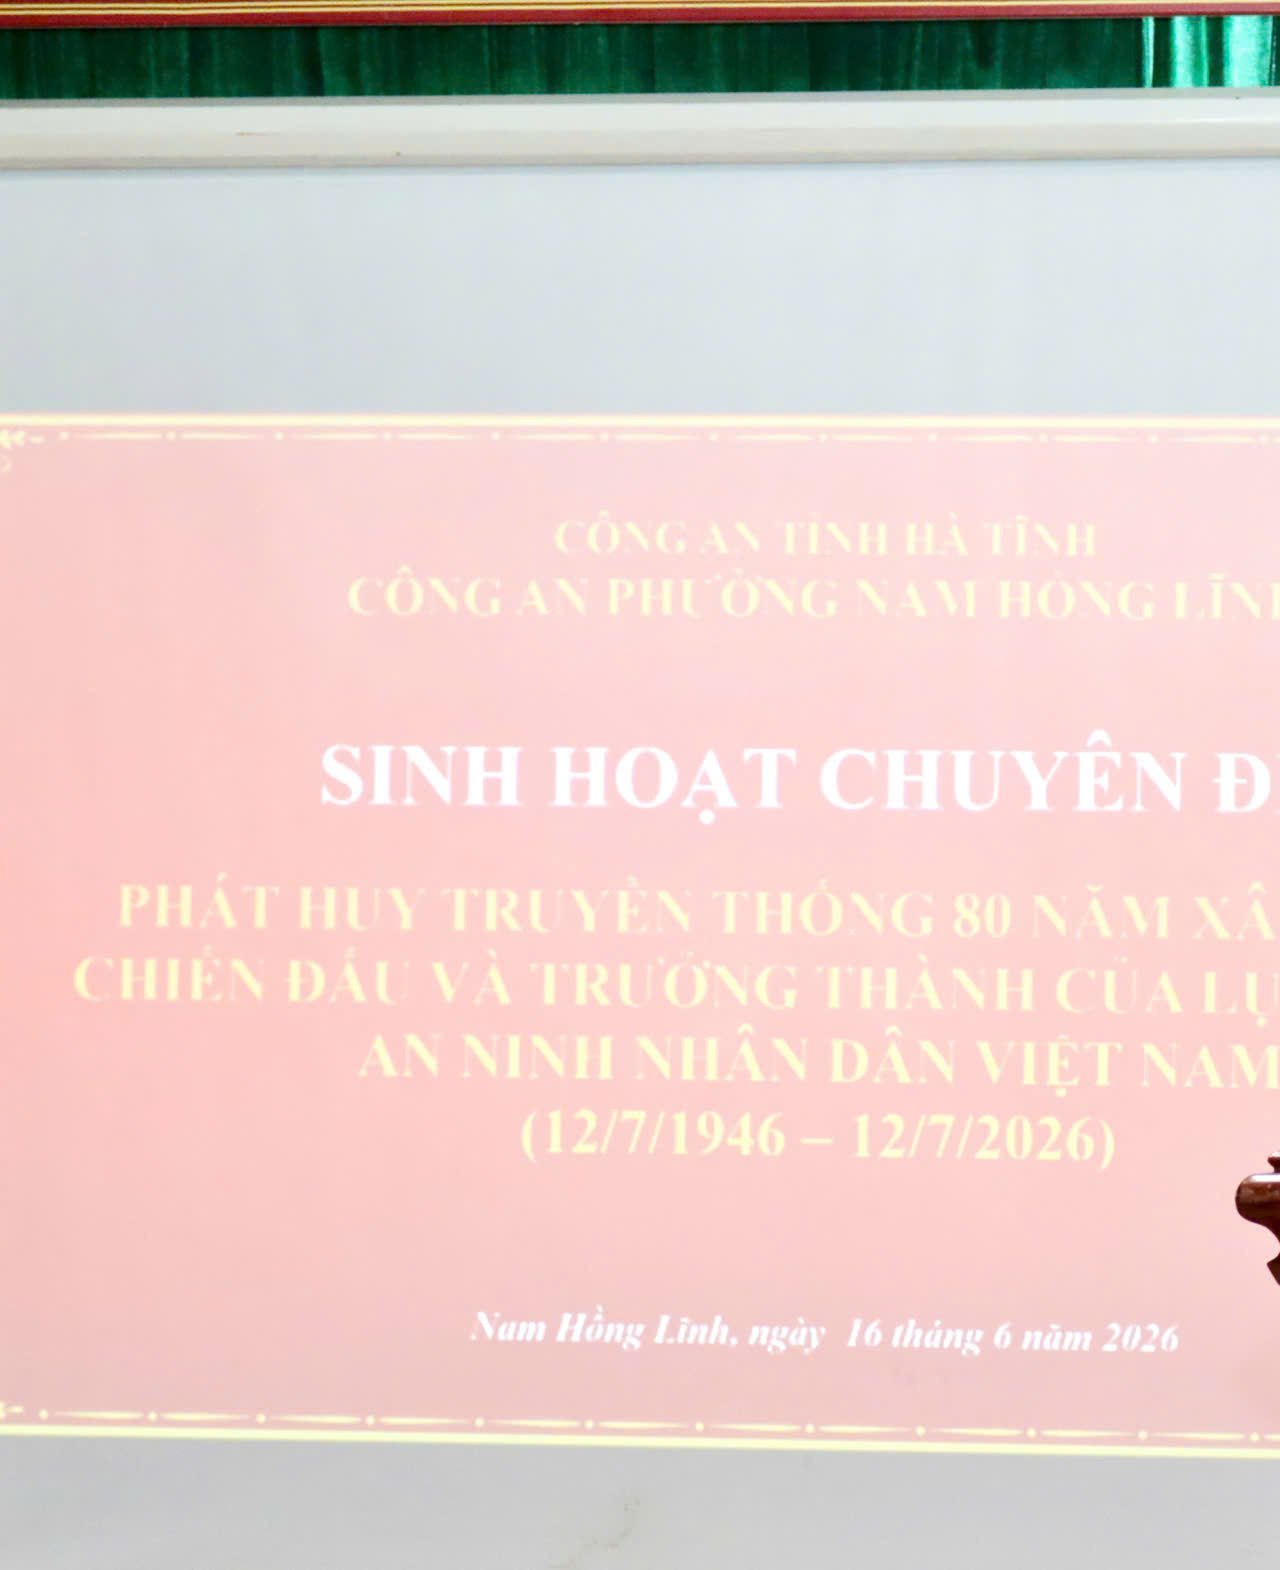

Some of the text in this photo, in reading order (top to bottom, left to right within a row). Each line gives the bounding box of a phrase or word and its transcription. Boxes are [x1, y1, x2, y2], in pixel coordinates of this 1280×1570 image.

[554, 510, 686, 555] CÔNG
[700, 520, 760, 554] AN
[905, 512, 968, 556] HÀ
[984, 515, 1096, 557] TĨNH
[347, 564, 502, 617] CÔNG
[516, 578, 588, 616] AN
[856, 579, 976, 618] NAM
[320, 744, 524, 807] SINH
[548, 744, 797, 824] HOẠT
[819, 729, 1188, 813] CHUYÊN
[120, 872, 280, 929] PHÁT
[298, 884, 424, 932] HUY
[712, 878, 934, 938] THỐNG
[952, 892, 1011, 939] 80
[1032, 882, 1170, 939] NĂM
[432, 948, 512, 1006] VÀ
[816, 952, 1034, 1012] THÀNH
[357, 1022, 1280, 1098] AN NINH NHÂN DÂN VIỆT NAM
[520, 1107, 786, 1164] (12/7/1946
[852, 1112, 1115, 1172] 12/7/2026)
[469, 1304, 1179, 1358] Nam Hồng Lĩnh, ngày 16 tháng 6 năm 2026
